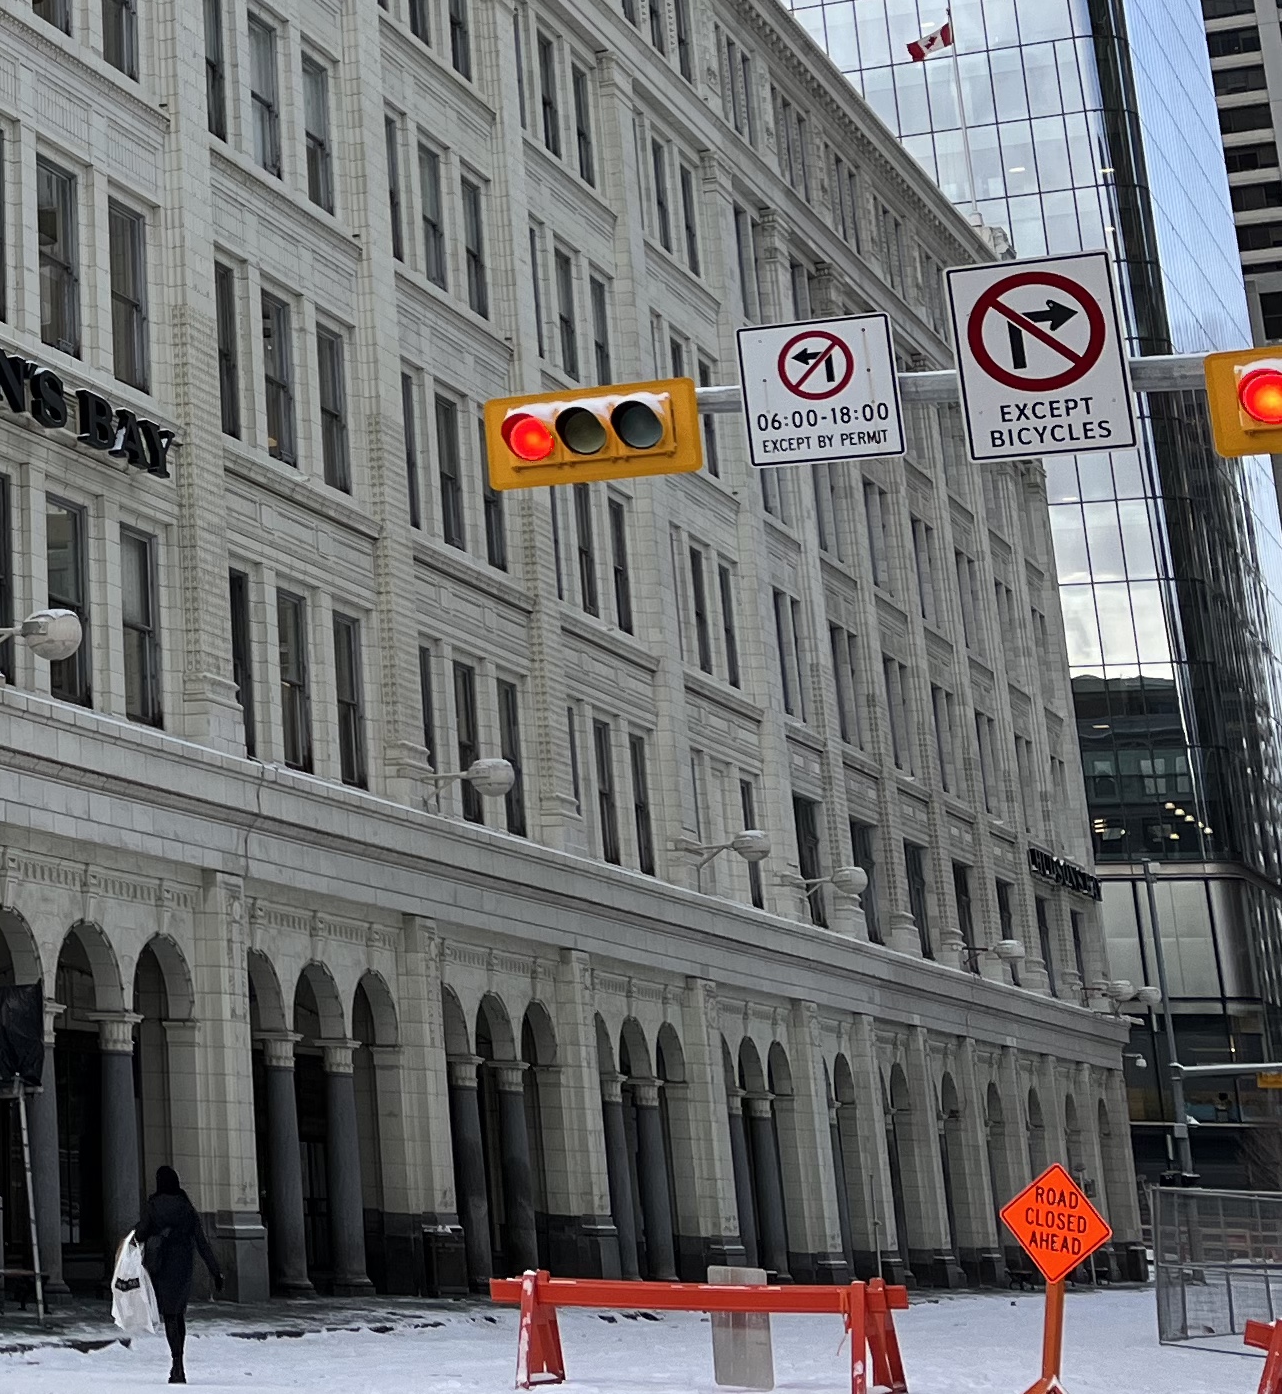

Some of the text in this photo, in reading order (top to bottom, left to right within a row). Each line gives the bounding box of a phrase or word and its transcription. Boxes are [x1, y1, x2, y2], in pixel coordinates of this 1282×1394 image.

[757, 402, 889, 432] 06:00-18:00
[1000, 397, 1094, 423] EXCEPT
[75, 388, 175, 479] BAY
[762, 429, 888, 454] EXCEPT BY PERMIT
[990, 420, 1112, 448] BICYCLES
[1035, 1185, 1079, 1210] ROAD
[1025, 1207, 1087, 1234] CLOSED
[1029, 1230, 1082, 1256] AHEAD
